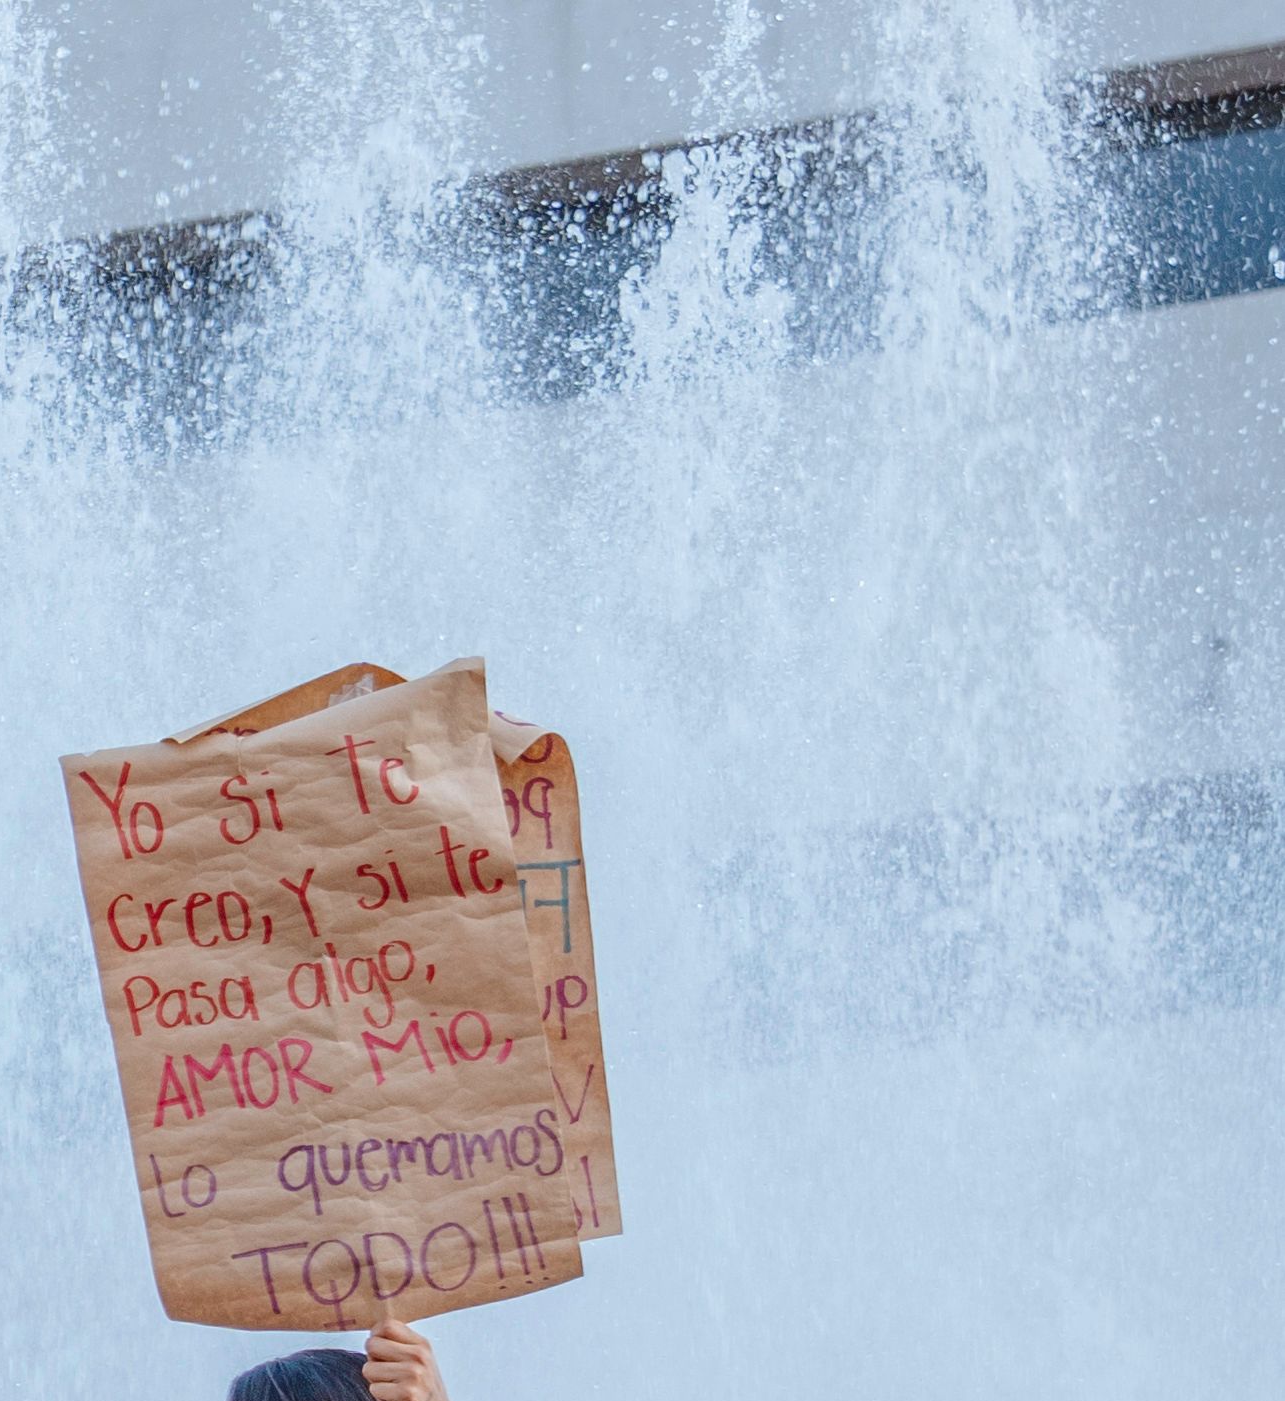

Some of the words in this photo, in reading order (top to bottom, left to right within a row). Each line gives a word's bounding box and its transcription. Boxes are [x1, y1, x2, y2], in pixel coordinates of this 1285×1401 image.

[78, 760, 164, 860] Yo
[287, 939, 438, 1030] algo,
[152, 1036, 334, 1128] AMOR
[276, 1107, 566, 1216] quemamos
